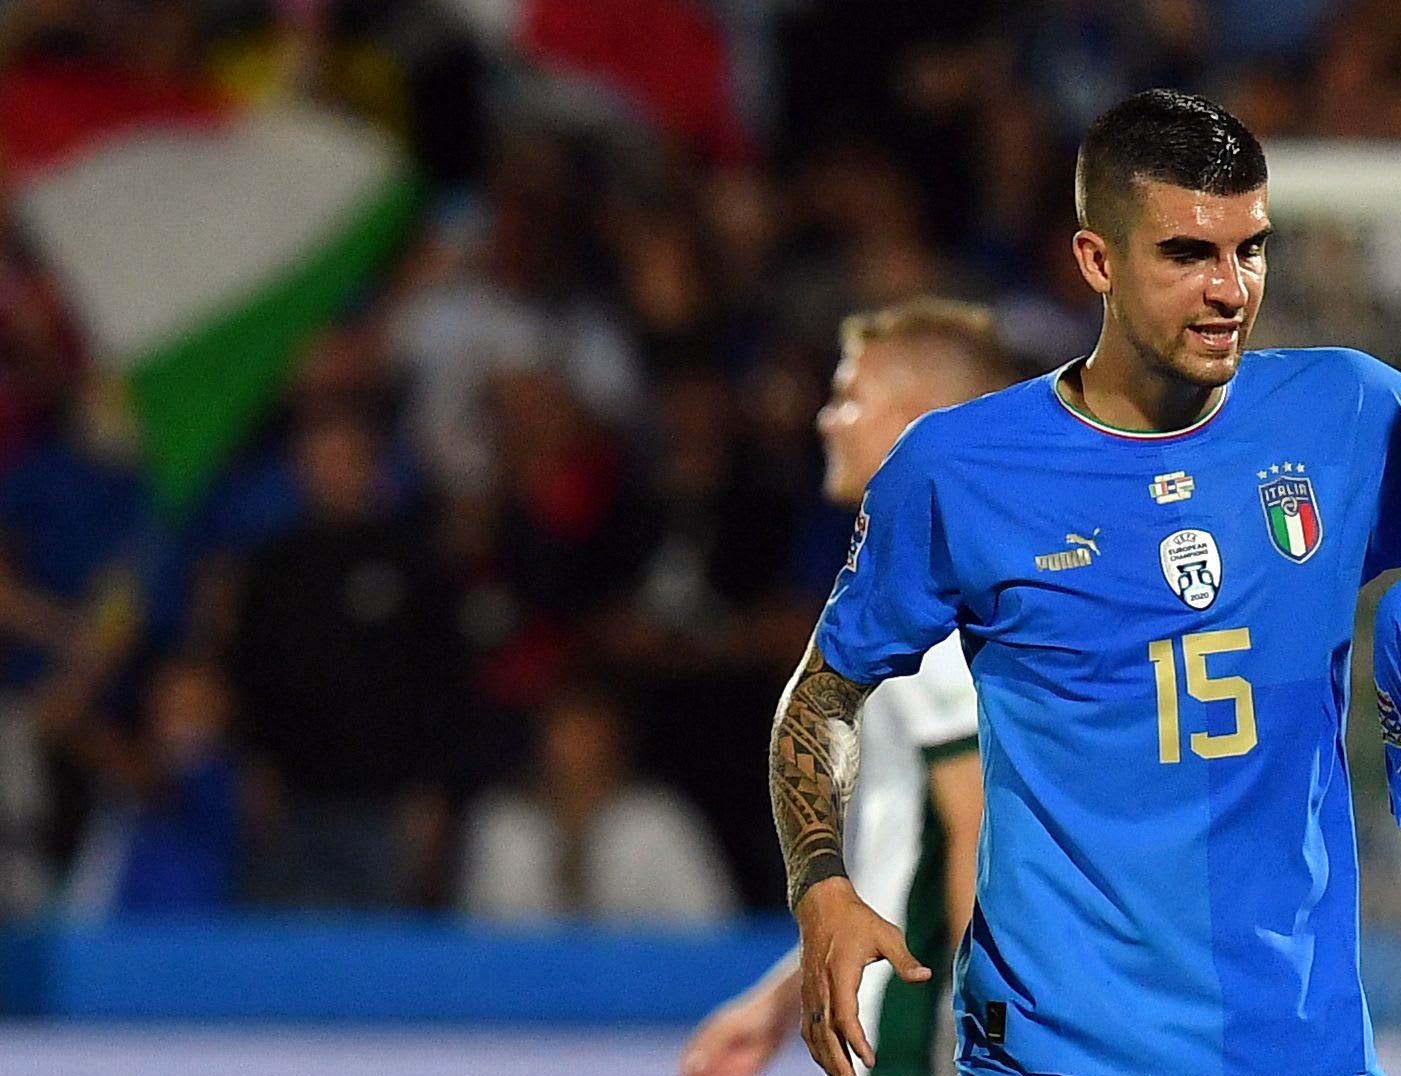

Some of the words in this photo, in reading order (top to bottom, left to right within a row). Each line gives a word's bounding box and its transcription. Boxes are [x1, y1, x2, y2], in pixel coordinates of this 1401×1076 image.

[1264, 483, 1308, 502] ITALIA
[1168, 543, 1208, 555] EUROPEAN
[1170, 549, 1209, 561] CHAMPIONS
[1190, 592, 1210, 601] 2020
[1148, 627, 1258, 764] 15
